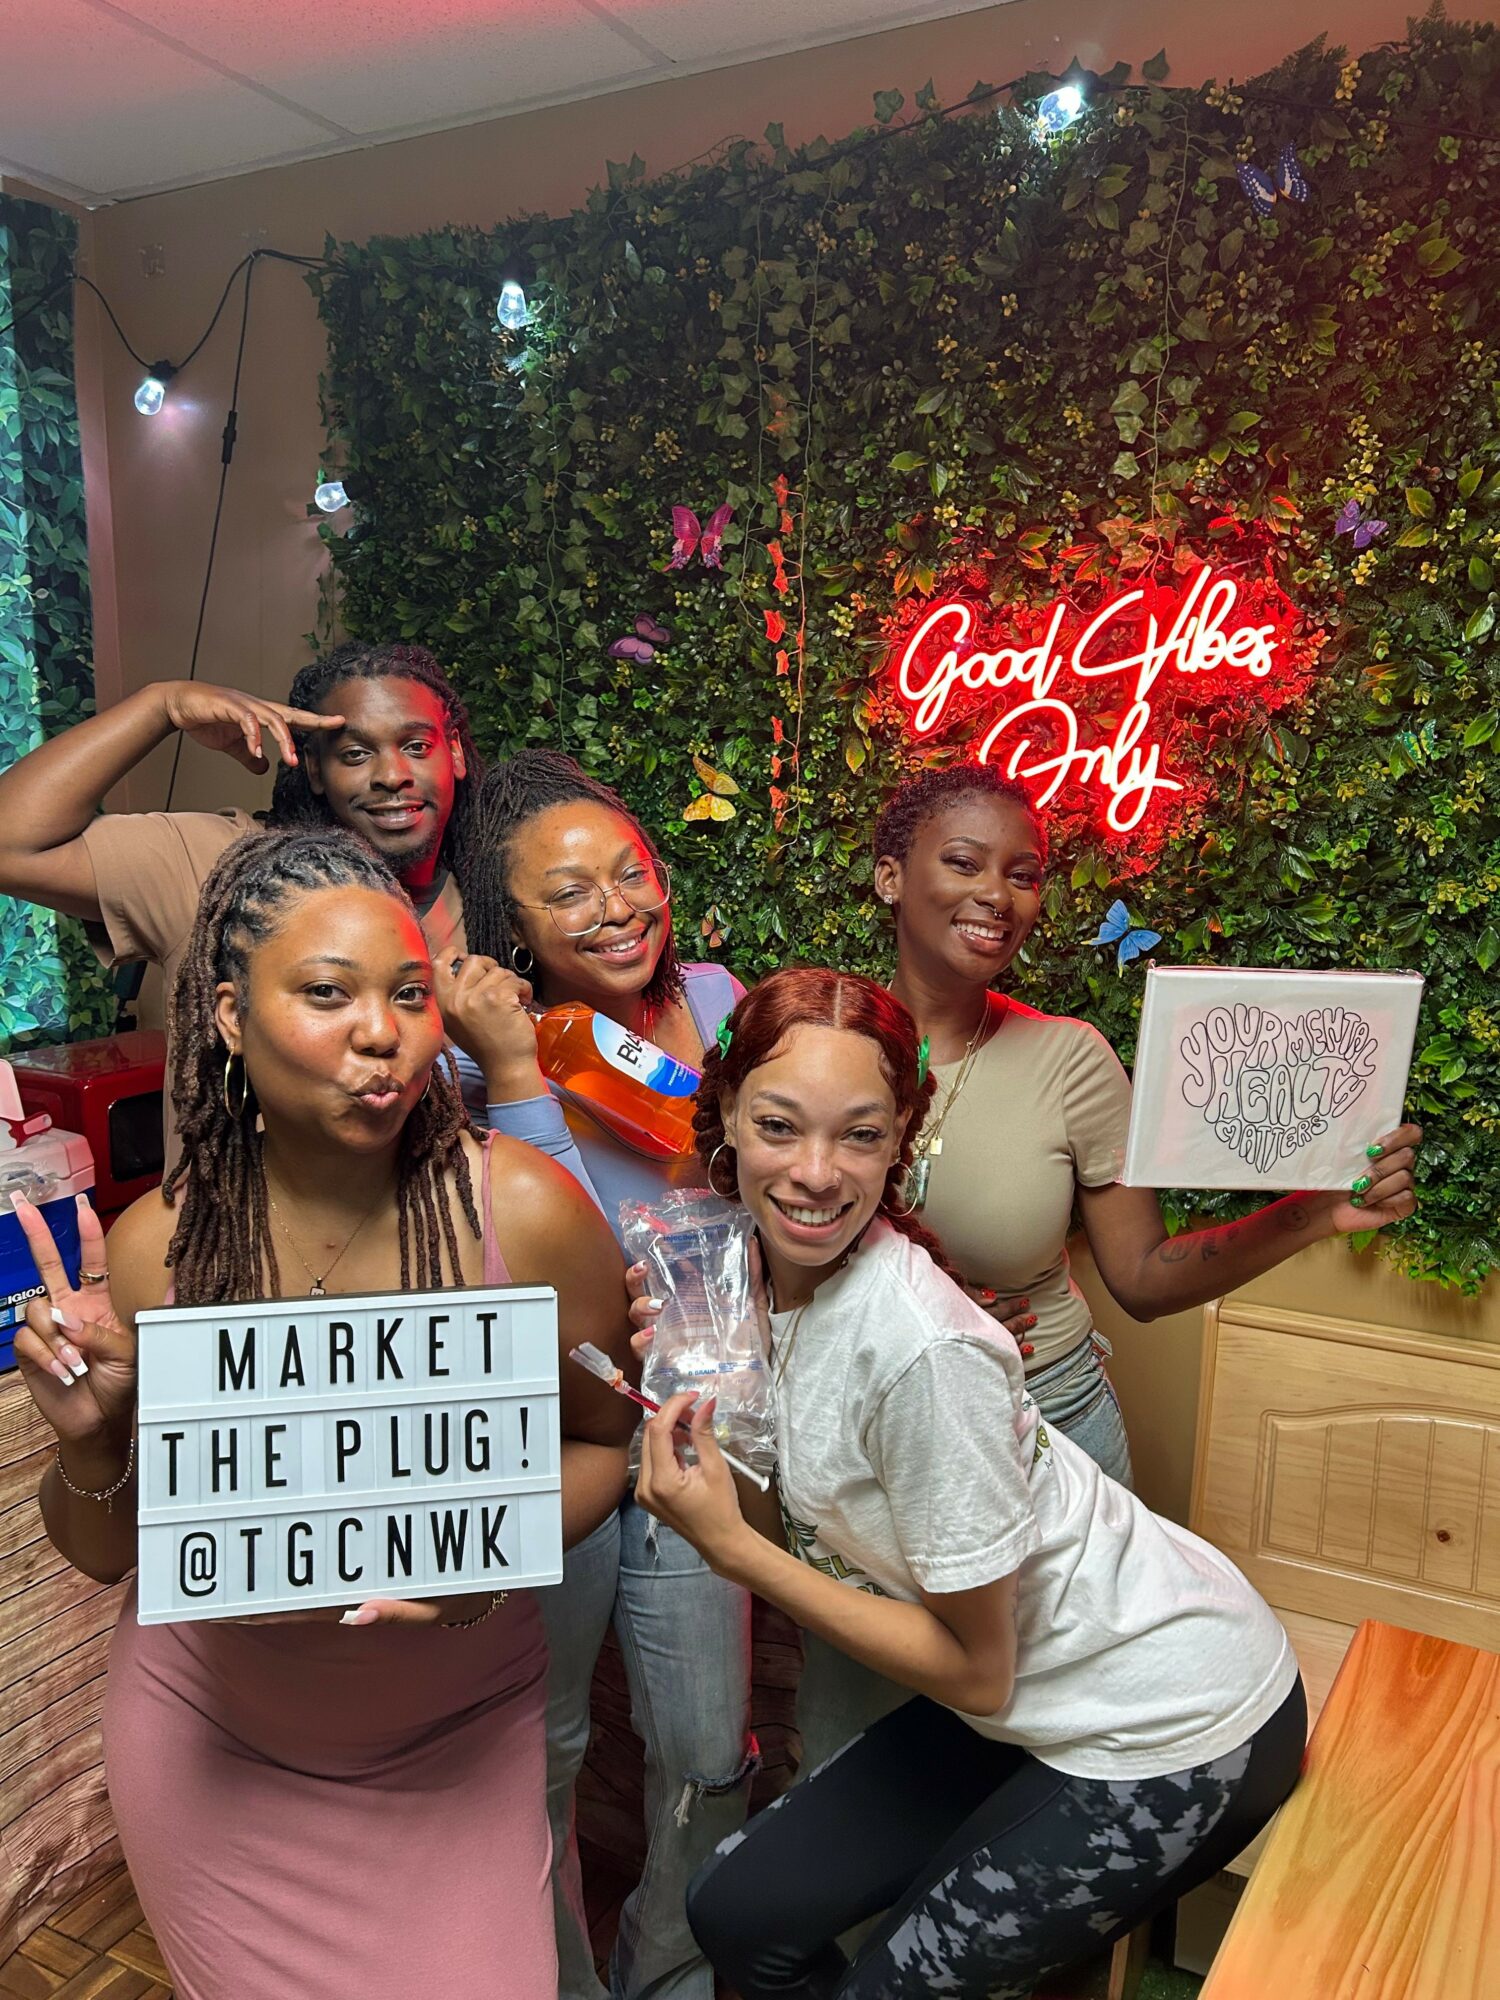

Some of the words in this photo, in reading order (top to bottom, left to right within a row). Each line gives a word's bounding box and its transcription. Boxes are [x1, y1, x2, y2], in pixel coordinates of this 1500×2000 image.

[899, 603, 1066, 732] Good
[1071, 565, 1282, 701] Vibes
[979, 698, 1184, 832] Only
[1180, 1003, 1283, 1108] YOUR
[1284, 1006, 1379, 1077] MENTAL
[1203, 1050, 1367, 1126] HEALTH
[1214, 1115, 1328, 1173] MATTERS
[7, 1285, 46, 1305] IGLOO
[218, 1312, 498, 1392] MARKET
[161, 1424, 287, 1497] THE
[335, 1406, 530, 1483] PLUG!
[179, 1505, 510, 1598] @TGCNWK
